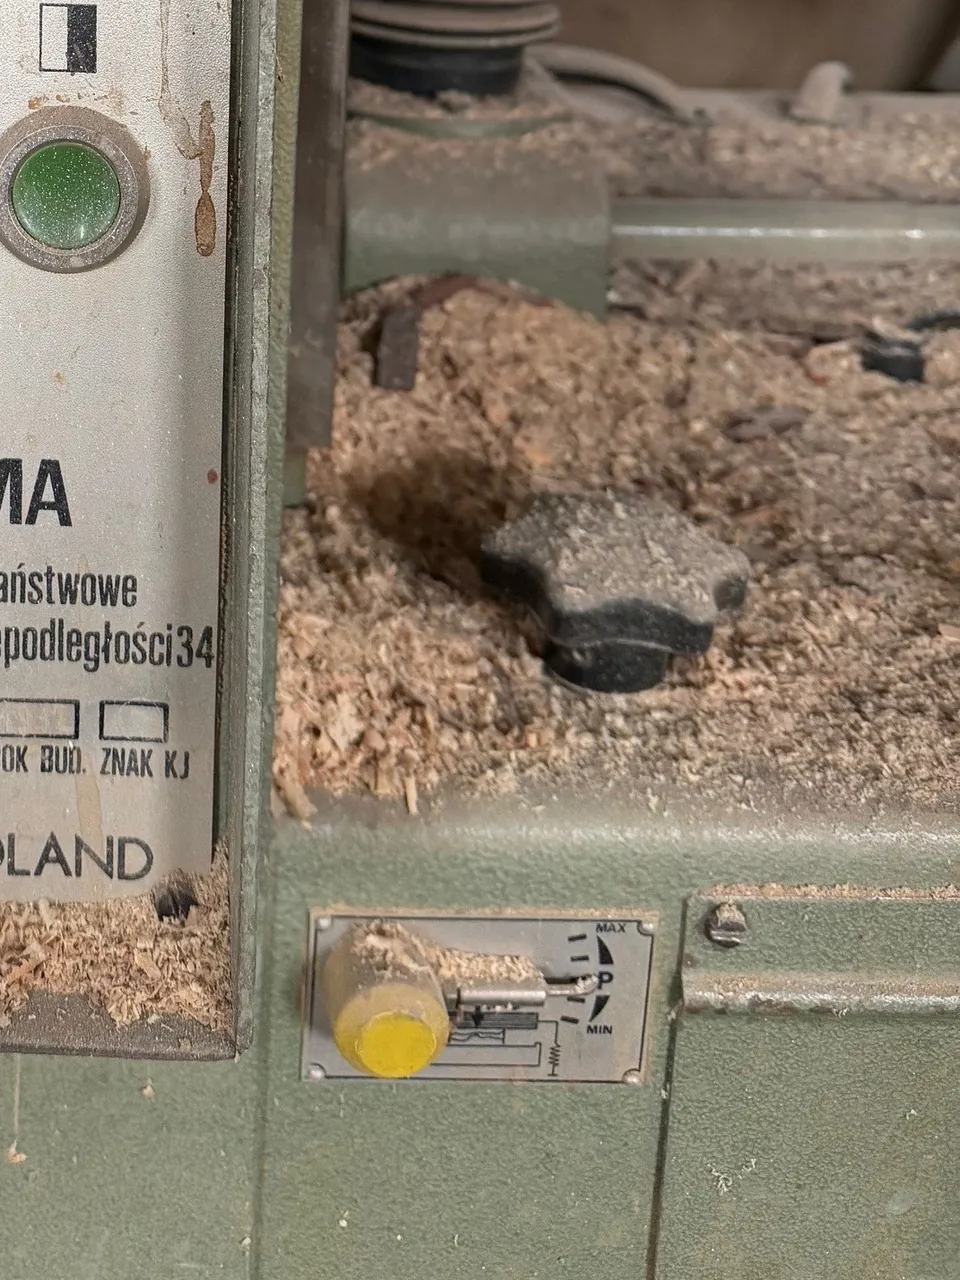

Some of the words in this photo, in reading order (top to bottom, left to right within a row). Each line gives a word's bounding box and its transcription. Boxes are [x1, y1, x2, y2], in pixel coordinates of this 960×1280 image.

[176, 626, 215, 668] 34
[41, 745, 86, 775] BUD.
[100, 748, 154, 778] ZNAK
[165, 751, 190, 780] KJ
[595, 921, 627, 933] MAX
[598, 970, 614, 990] P
[586, 1025, 614, 1036] MIN
